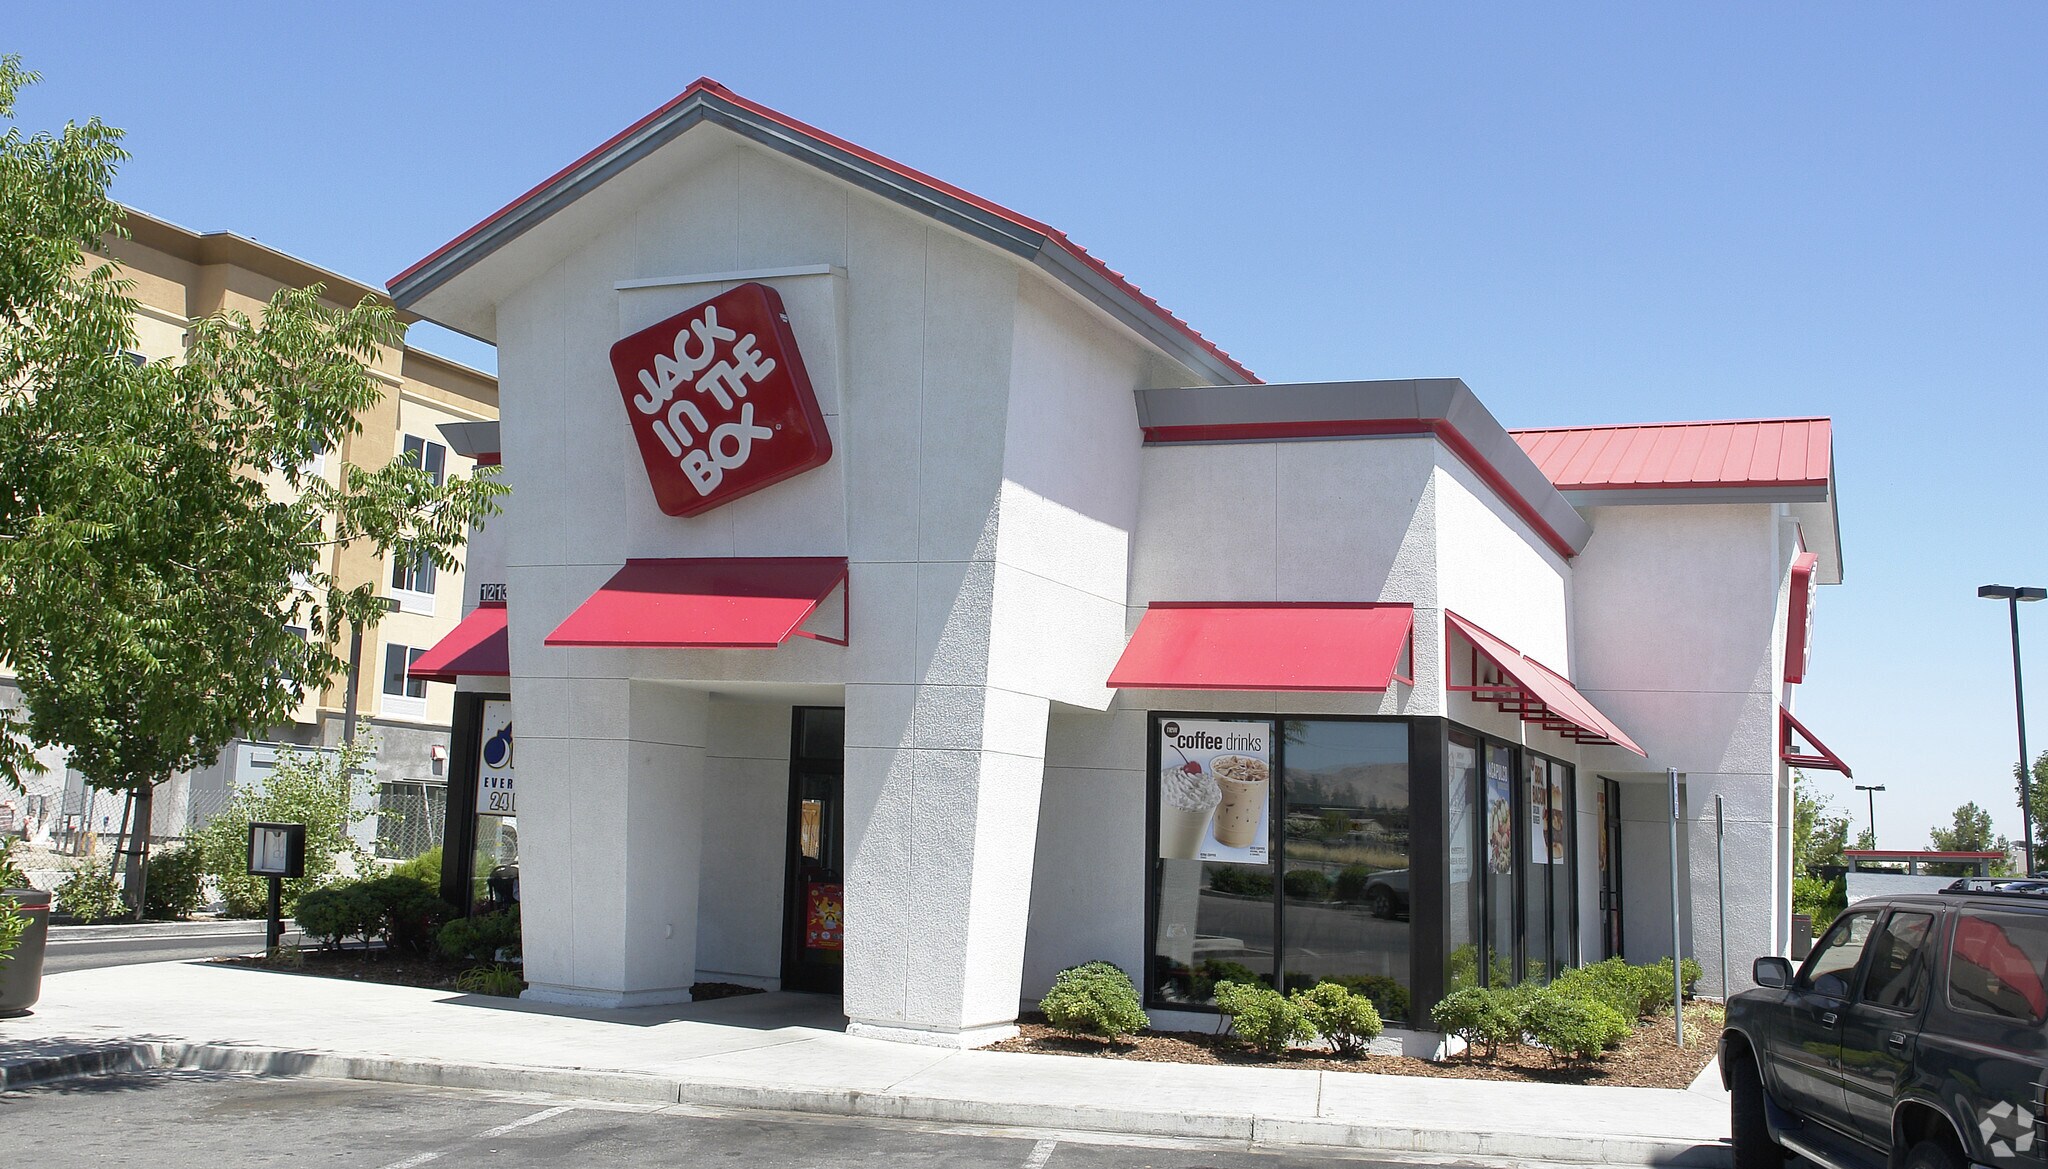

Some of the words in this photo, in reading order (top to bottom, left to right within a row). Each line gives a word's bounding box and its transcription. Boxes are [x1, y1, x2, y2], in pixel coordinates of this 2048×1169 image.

[634, 305, 736, 414] JACK
[695, 333, 776, 410] THE
[680, 402, 773, 496] BOX
[1177, 731, 1222, 750] coffee
[1226, 732, 1261, 751] drinks
[489, 791, 510, 811] 24
